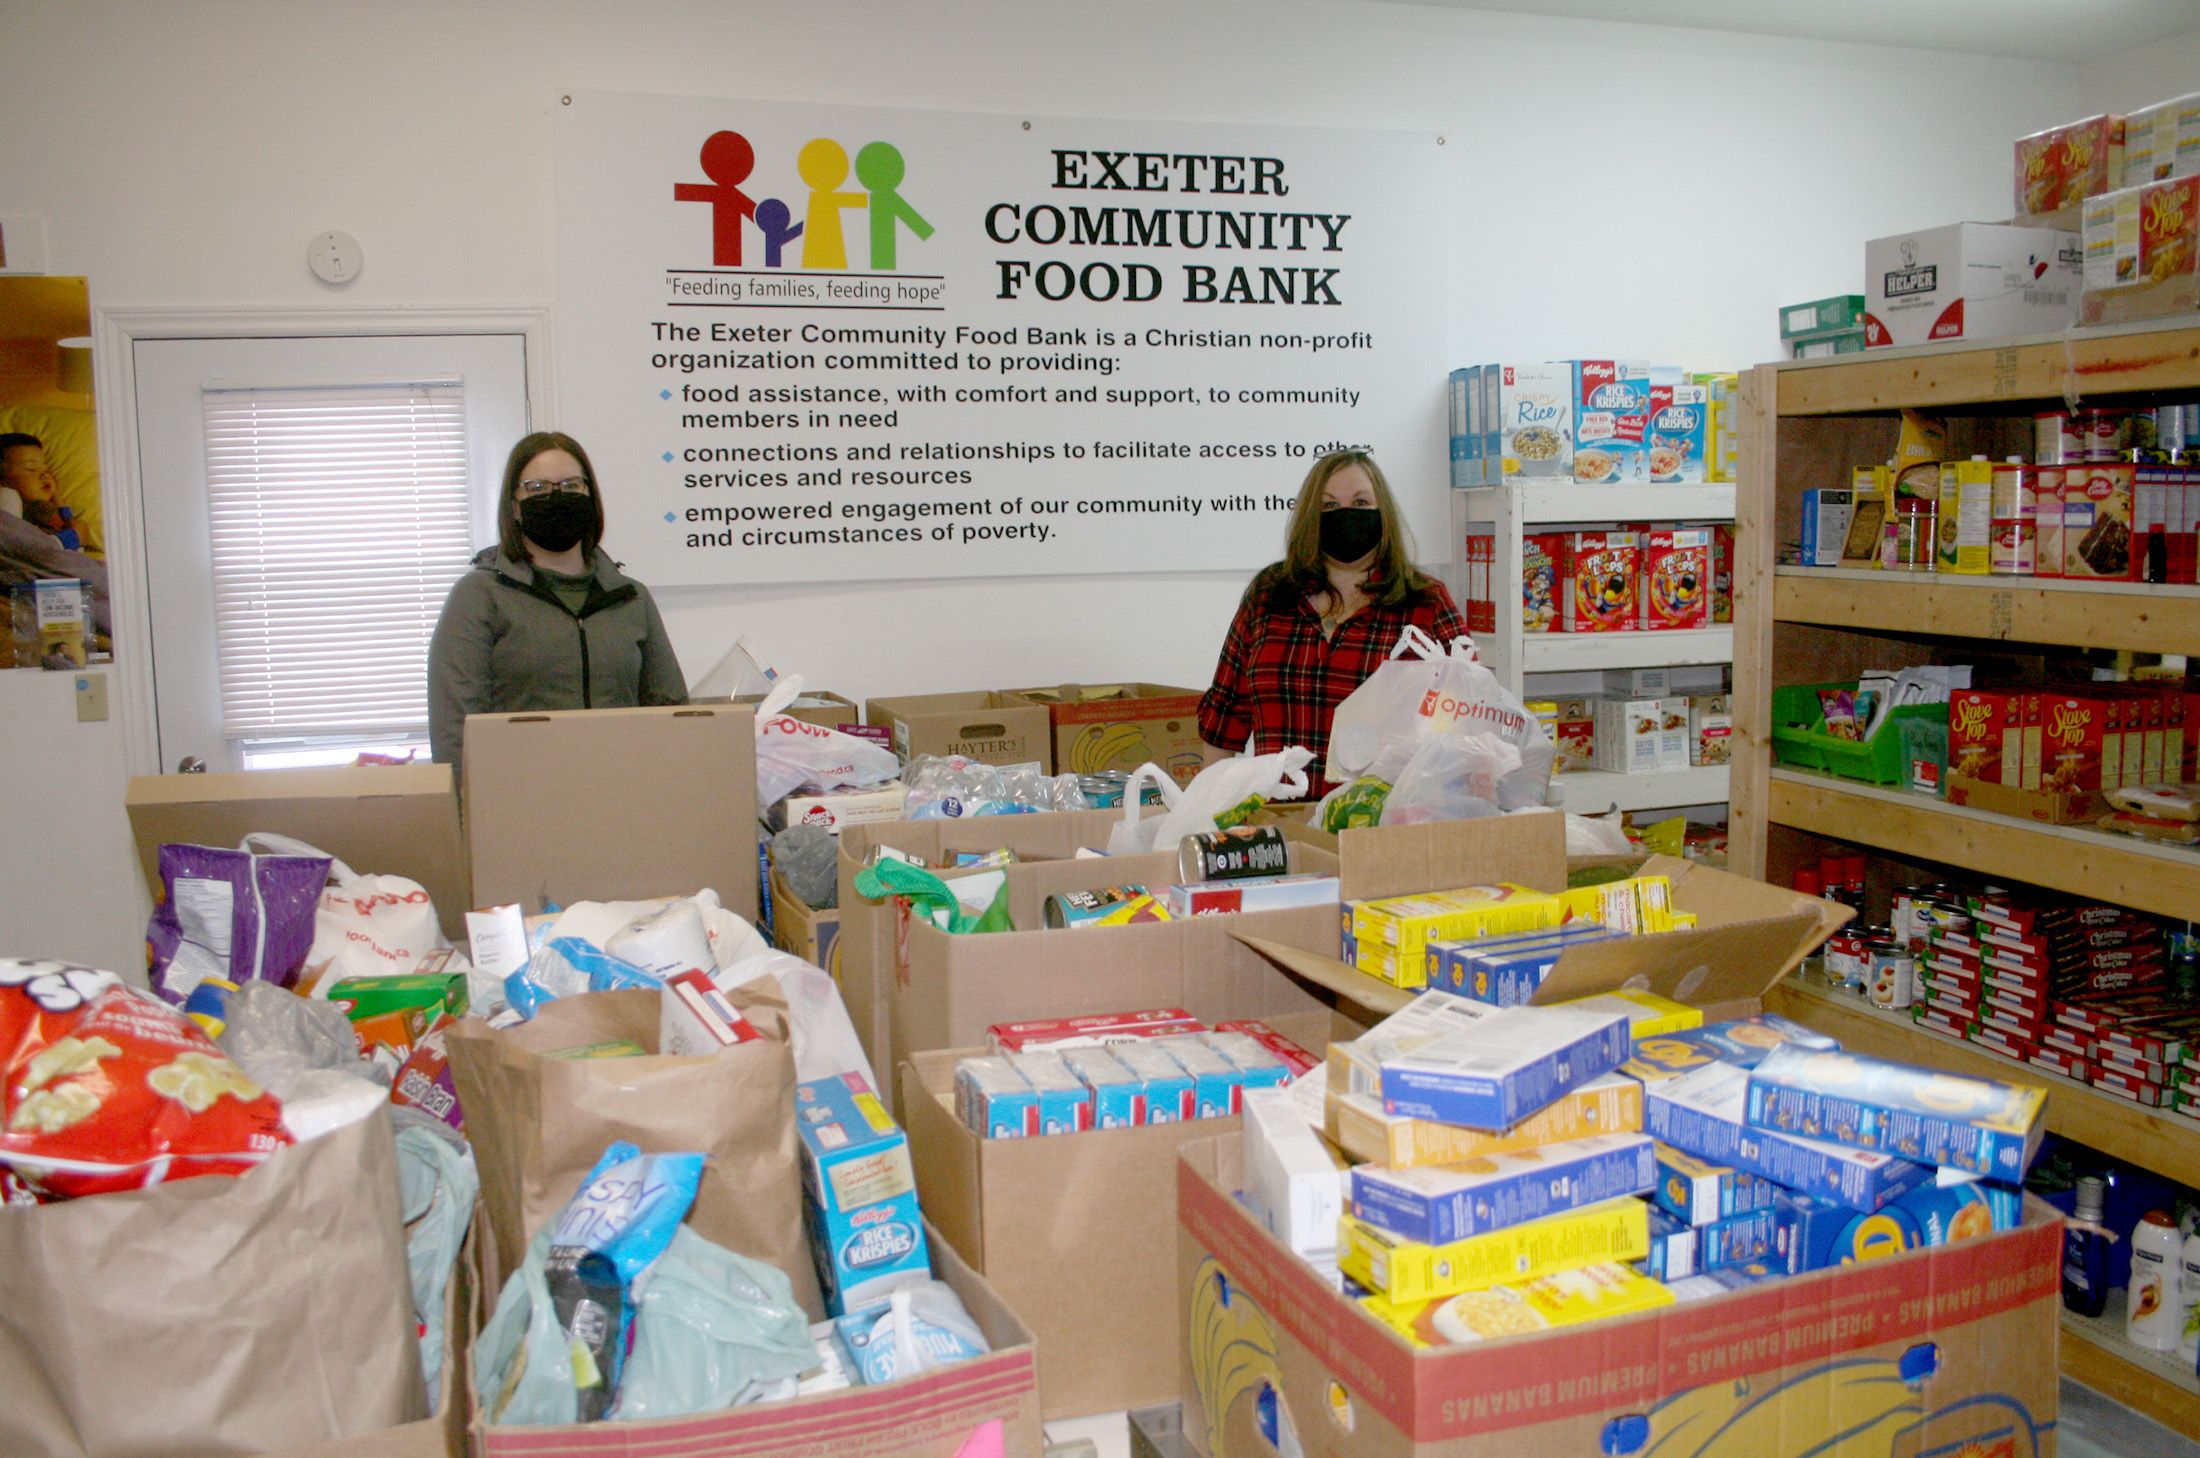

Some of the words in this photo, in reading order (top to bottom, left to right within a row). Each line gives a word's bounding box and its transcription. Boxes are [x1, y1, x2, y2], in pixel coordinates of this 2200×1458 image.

[1051, 150, 1289, 197] EXETER
[985, 203, 1351, 252] COMMUNITY
[666, 277, 742, 301] "Feeding
[749, 278, 820, 300] families,
[827, 280, 891, 304] feeding
[898, 282, 946, 304] hope"
[996, 260, 1162, 302] FOOD
[1182, 264, 1342, 306] BANK
[1887, 271, 1934, 293] HELPER
[651, 322, 701, 342] The
[711, 323, 793, 342] Exeter
[801, 324, 947, 350] Community
[956, 326, 1018, 346] Food
[1027, 327, 1088, 346] Bank
[1096, 328, 1116, 346] is
[1124, 332, 1137, 347] a
[1145, 329, 1252, 348] Christian
[1260, 331, 1373, 353] non-profit
[651, 350, 815, 374] organization
[825, 352, 959, 371] committed
[967, 352, 992, 370] to
[1000, 352, 1121, 376] providing:
[682, 384, 739, 403] food
[748, 385, 889, 406] assistance,
[897, 384, 947, 403] with
[955, 384, 1048, 403] comfort
[1055, 386, 1097, 403] and
[1106, 387, 1201, 408] support,
[1209, 387, 1231, 404] to
[1238, 387, 1361, 408] community
[1595, 394, 1635, 409] KRISPIES
[1605, 384, 1625, 398] RICE
[682, 410, 800, 429] members
[808, 410, 830, 428] in
[839, 410, 898, 428] need
[1518, 400, 1557, 424] Rice
[1658, 416, 1694, 431] KRISPIES
[1667, 406, 1685, 419] RICE
[683, 443, 839, 463] connections
[847, 442, 891, 461] and
[900, 442, 1056, 464] relationships
[1063, 442, 1086, 459] to
[1093, 441, 1192, 459] facilitate
[1199, 445, 1277, 459] access
[1284, 441, 1306, 458] to
[684, 468, 789, 488] services
[796, 468, 842, 487] and
[851, 470, 973, 486] resources
[684, 501, 833, 527] empowered
[841, 499, 993, 523] engagement
[1000, 496, 1024, 515] of
[1031, 500, 1070, 515] our
[1076, 495, 1203, 517] community
[1210, 495, 1256, 512] with
[686, 529, 733, 548] and
[741, 525, 923, 547] circumstances
[930, 523, 955, 541] of
[962, 522, 1057, 545] poverty.
[1587, 551, 1621, 568] FROOT
[1594, 560, 1624, 576] LOOPS
[1661, 551, 1693, 567] FROOT
[1667, 560, 1695, 575] LOOPS
[1442, 697, 1526, 734] optimum
[1952, 698, 1993, 733] Stove
[2048, 703, 2092, 738] Stove
[1965, 721, 1987, 742] Top
[2063, 728, 2085, 747] Top
[947, 739, 1017, 756] HAYTER'S
[802, 809, 832, 824] Snack
[251, 1133, 275, 1150] 130
[851, 1206, 896, 1225] Kellogg's
[863, 1225, 895, 1247] RICE
[850, 1236, 912, 1266] KRISPIES
[1900, 1283, 1982, 1325] BANANAS
[1785, 1310, 1875, 1348] PREMIUM
[1687, 1331, 1780, 1375] BANANAS
[1558, 1360, 1660, 1403] PREMIUM
[1441, 1381, 1550, 1424] BANANAS
